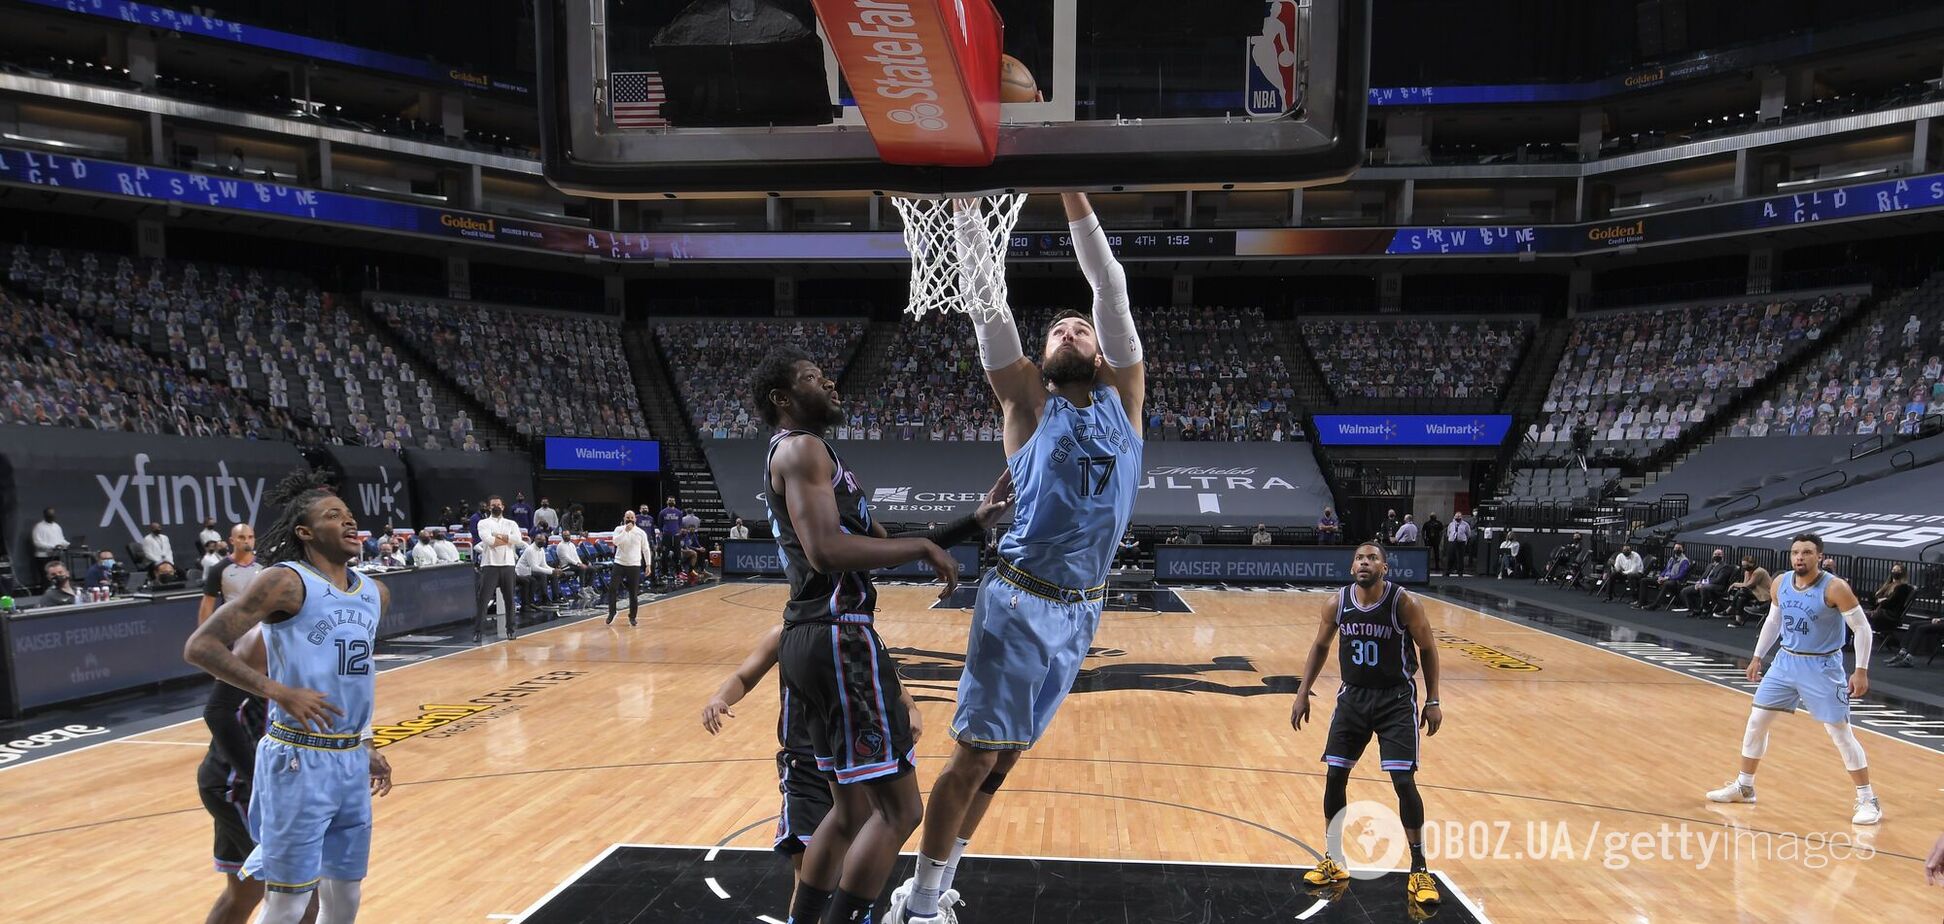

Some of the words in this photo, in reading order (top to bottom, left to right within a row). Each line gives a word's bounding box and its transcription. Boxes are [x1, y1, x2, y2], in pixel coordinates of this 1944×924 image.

[848, 0, 938, 101] StateFar
[1253, 90, 1277, 109] NBA
[1059, 236, 1072, 246] SA
[1108, 236, 1122, 246] 08
[1135, 236, 1156, 246] 4TH
[1167, 235, 1190, 245] 1:52
[1078, 455, 1116, 496] 17
[96, 453, 266, 545] xfinity
[888, 504, 956, 512] RESORT
[1782, 511, 1944, 524] SACRAMEN
[1704, 519, 1944, 548] KINGS
[1169, 560, 1221, 575] KAISER
[1227, 561, 1335, 577] PERMANENTE
[1340, 623, 1393, 639] SACTOWN
[1783, 615, 1809, 635] 24
[15, 632, 62, 652] KAISER
[334, 639, 369, 675] 12
[1351, 639, 1378, 667] 30
[71, 665, 111, 683] thrive
[469, 670, 589, 704] CENTER
